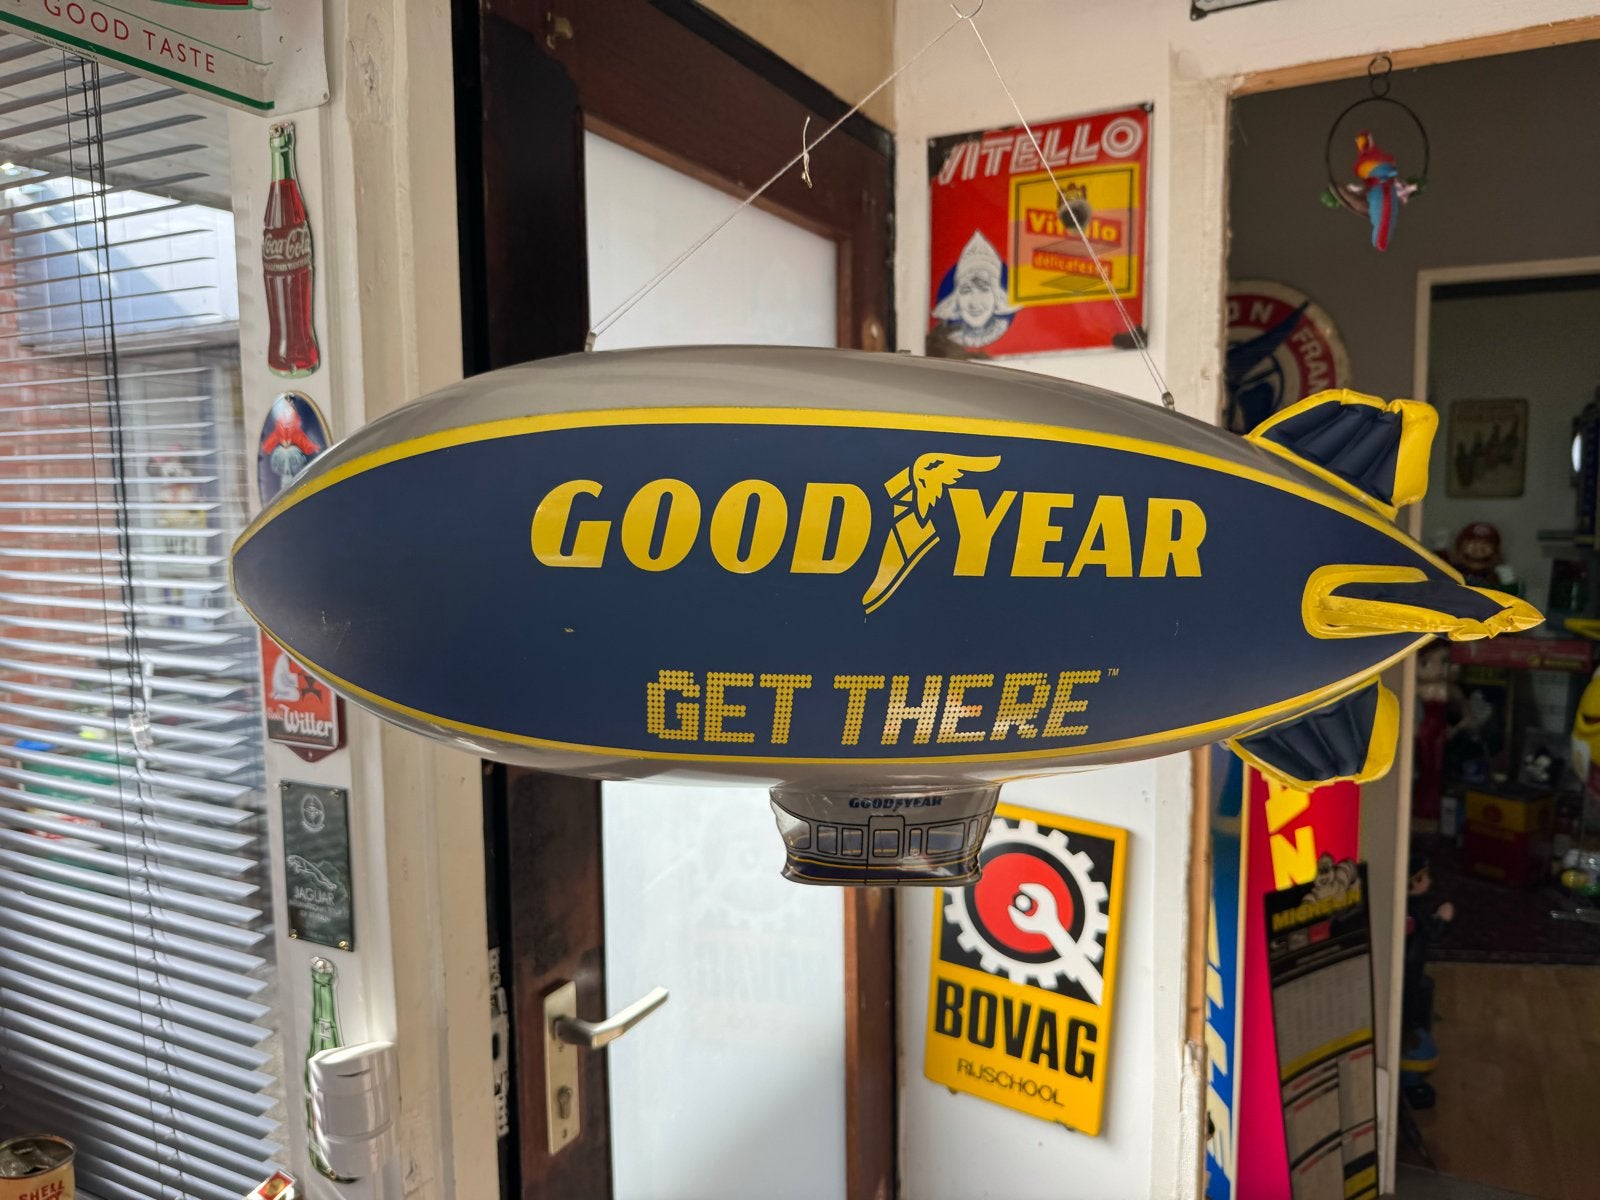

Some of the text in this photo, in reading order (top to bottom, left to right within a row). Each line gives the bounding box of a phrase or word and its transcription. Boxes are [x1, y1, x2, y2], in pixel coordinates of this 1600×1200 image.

[44, 0, 129, 41] GOOD
[143, 29, 216, 74] TASTE
[647, 670, 812, 744] GET
[834, 670, 1101, 745] THERE
[294, 886, 335, 906] JAGUAR
[935, 977, 1098, 1083] BOVAG
